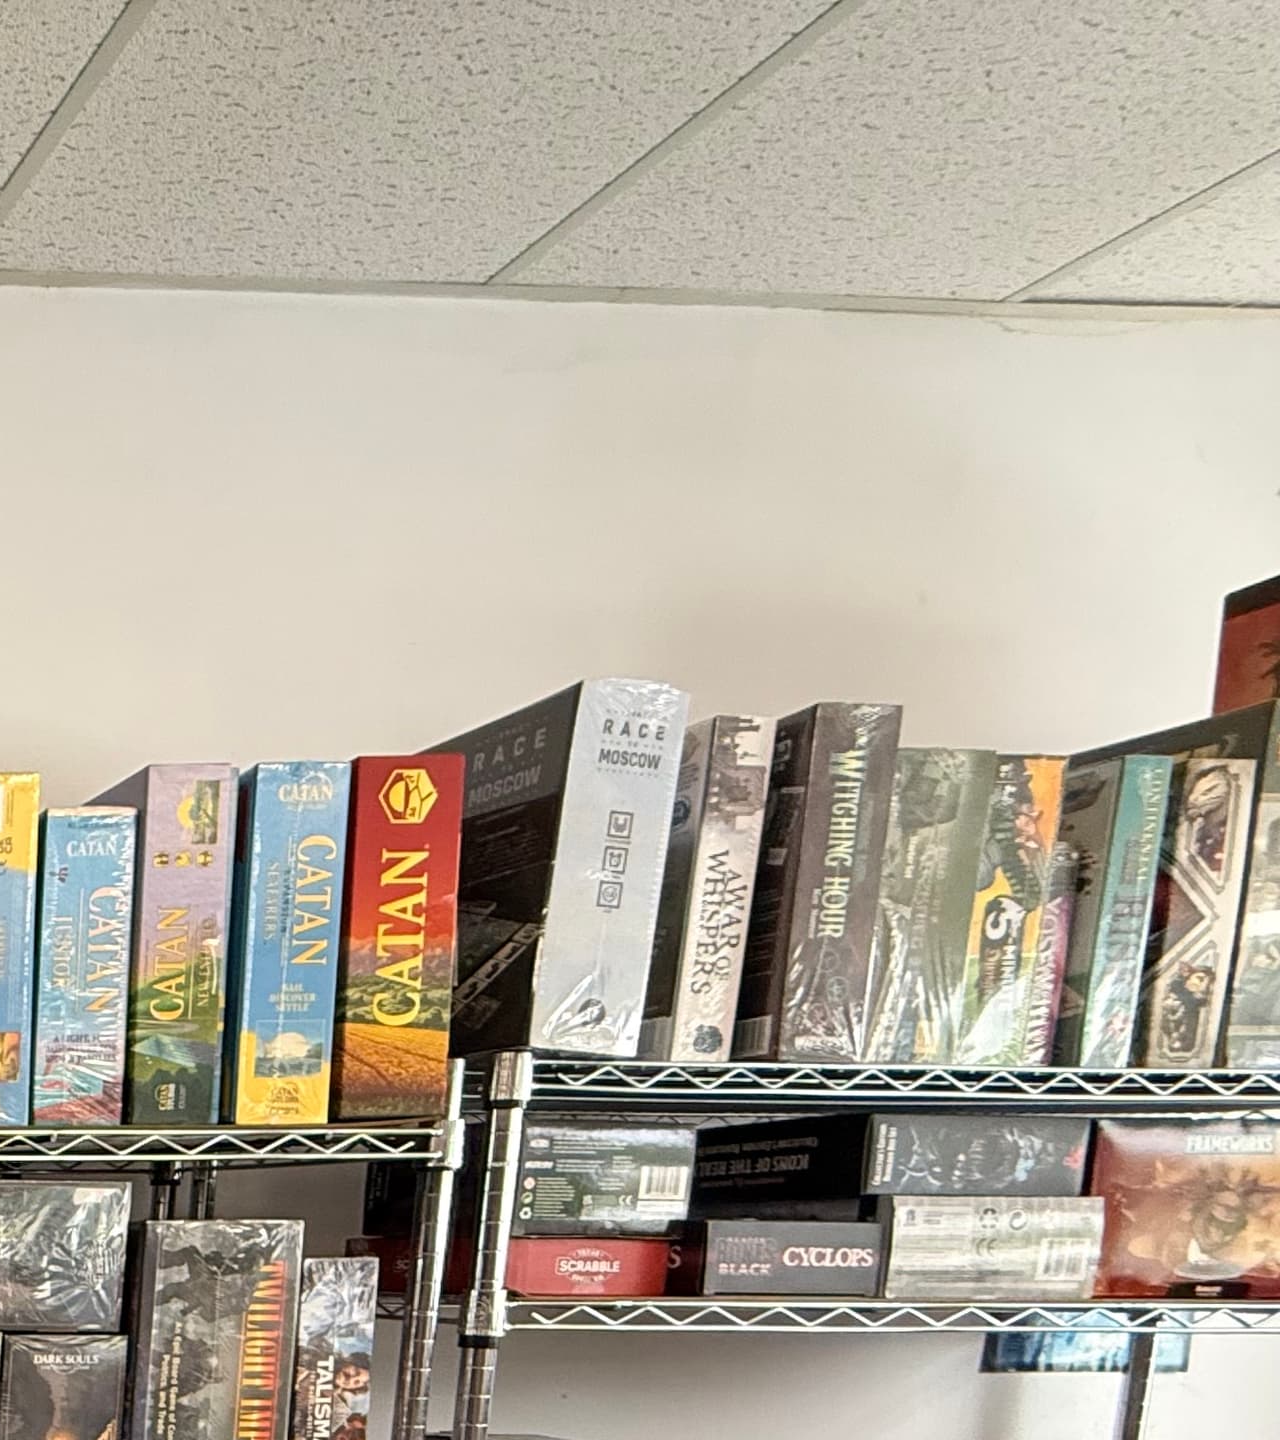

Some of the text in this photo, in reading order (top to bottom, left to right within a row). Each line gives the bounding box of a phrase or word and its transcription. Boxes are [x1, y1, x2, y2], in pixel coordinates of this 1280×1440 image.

[598, 749, 661, 770] MOSCOW
[603, 719, 666, 742] RACE
[278, 783, 333, 802] CATAN
[67, 840, 117, 857] CATAN
[819, 750, 866, 938] WITCHING HOUR
[291, 833, 337, 966] CATAN
[690, 850, 729, 996] WHISPERS
[86, 886, 122, 1012] CATAN
[151, 906, 189, 1020] CATAN
[373, 848, 429, 1026] CATAN
[1185, 1133, 1274, 1155] FRAMEWORKS
[555, 1257, 621, 1274] SCRABBLE
[783, 1247, 873, 1267] CYCLOPS
[241, 1260, 287, 1394] TWILIGHT
